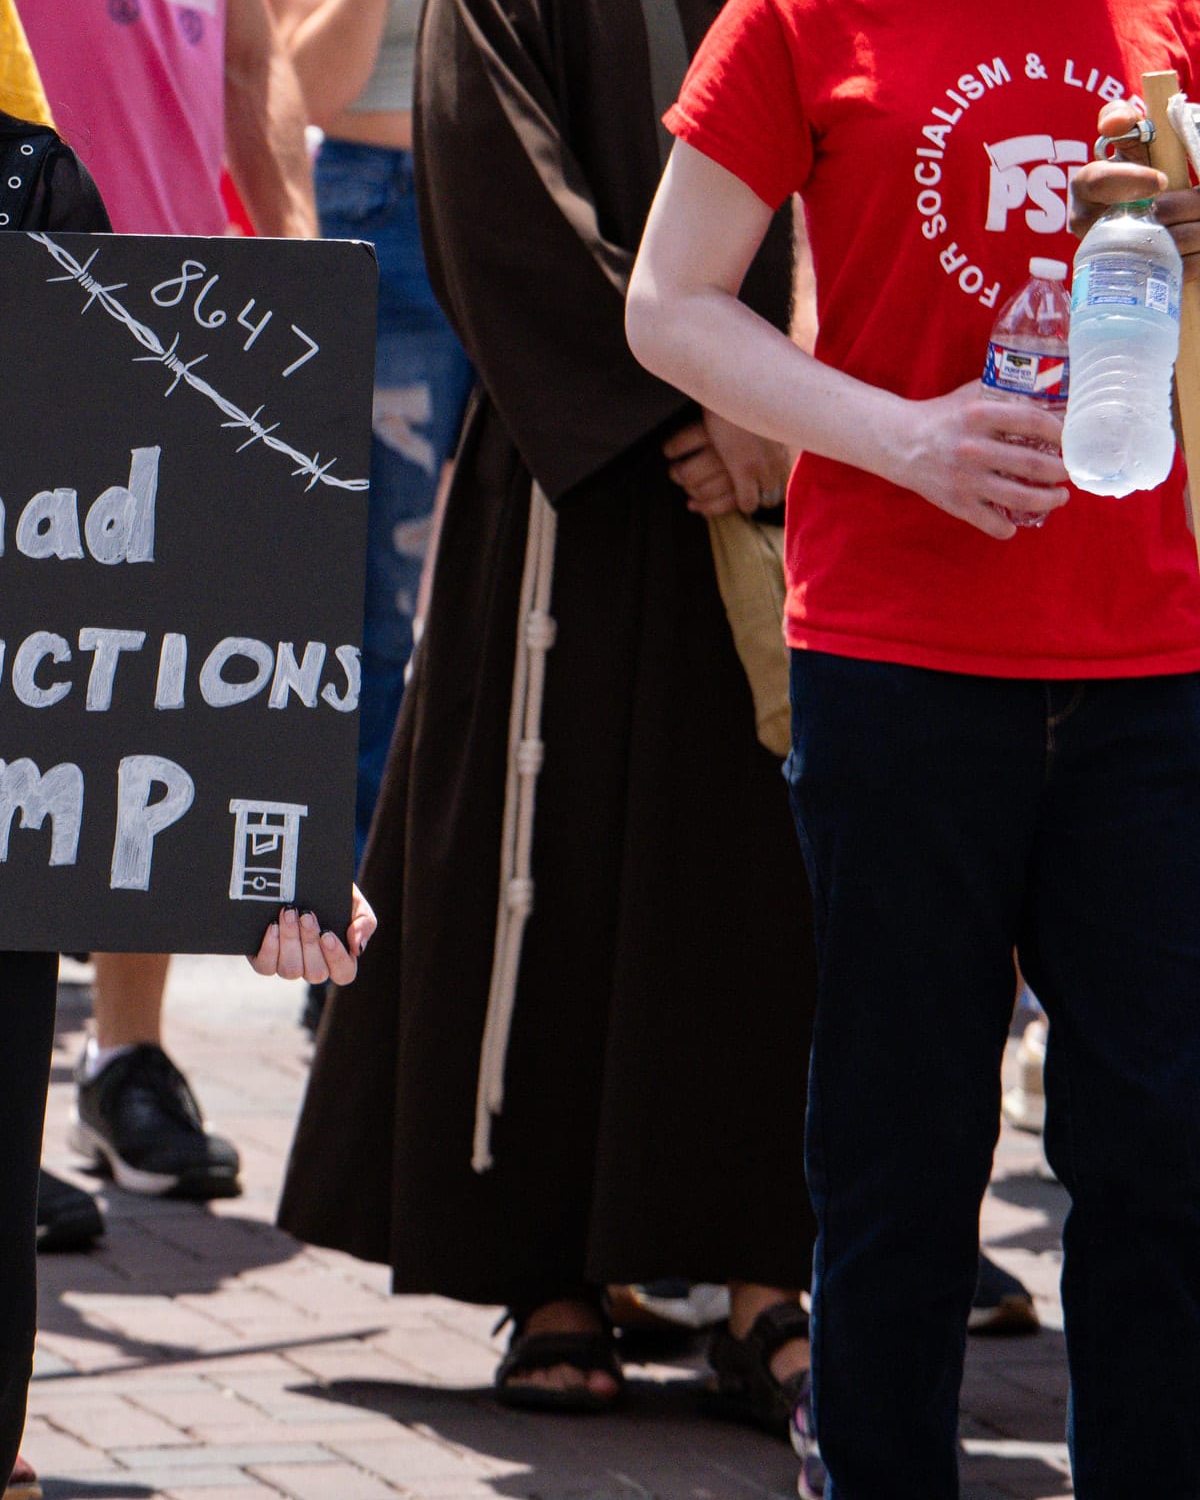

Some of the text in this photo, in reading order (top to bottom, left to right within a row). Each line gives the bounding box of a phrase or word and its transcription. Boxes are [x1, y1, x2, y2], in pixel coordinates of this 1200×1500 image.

[914, 57, 1012, 240] SOCIALISM
[1024, 52, 1049, 80] &
[984, 162, 1086, 235] PS
[150, 259, 320, 378] 8647
[939, 242, 1001, 309] FOR
